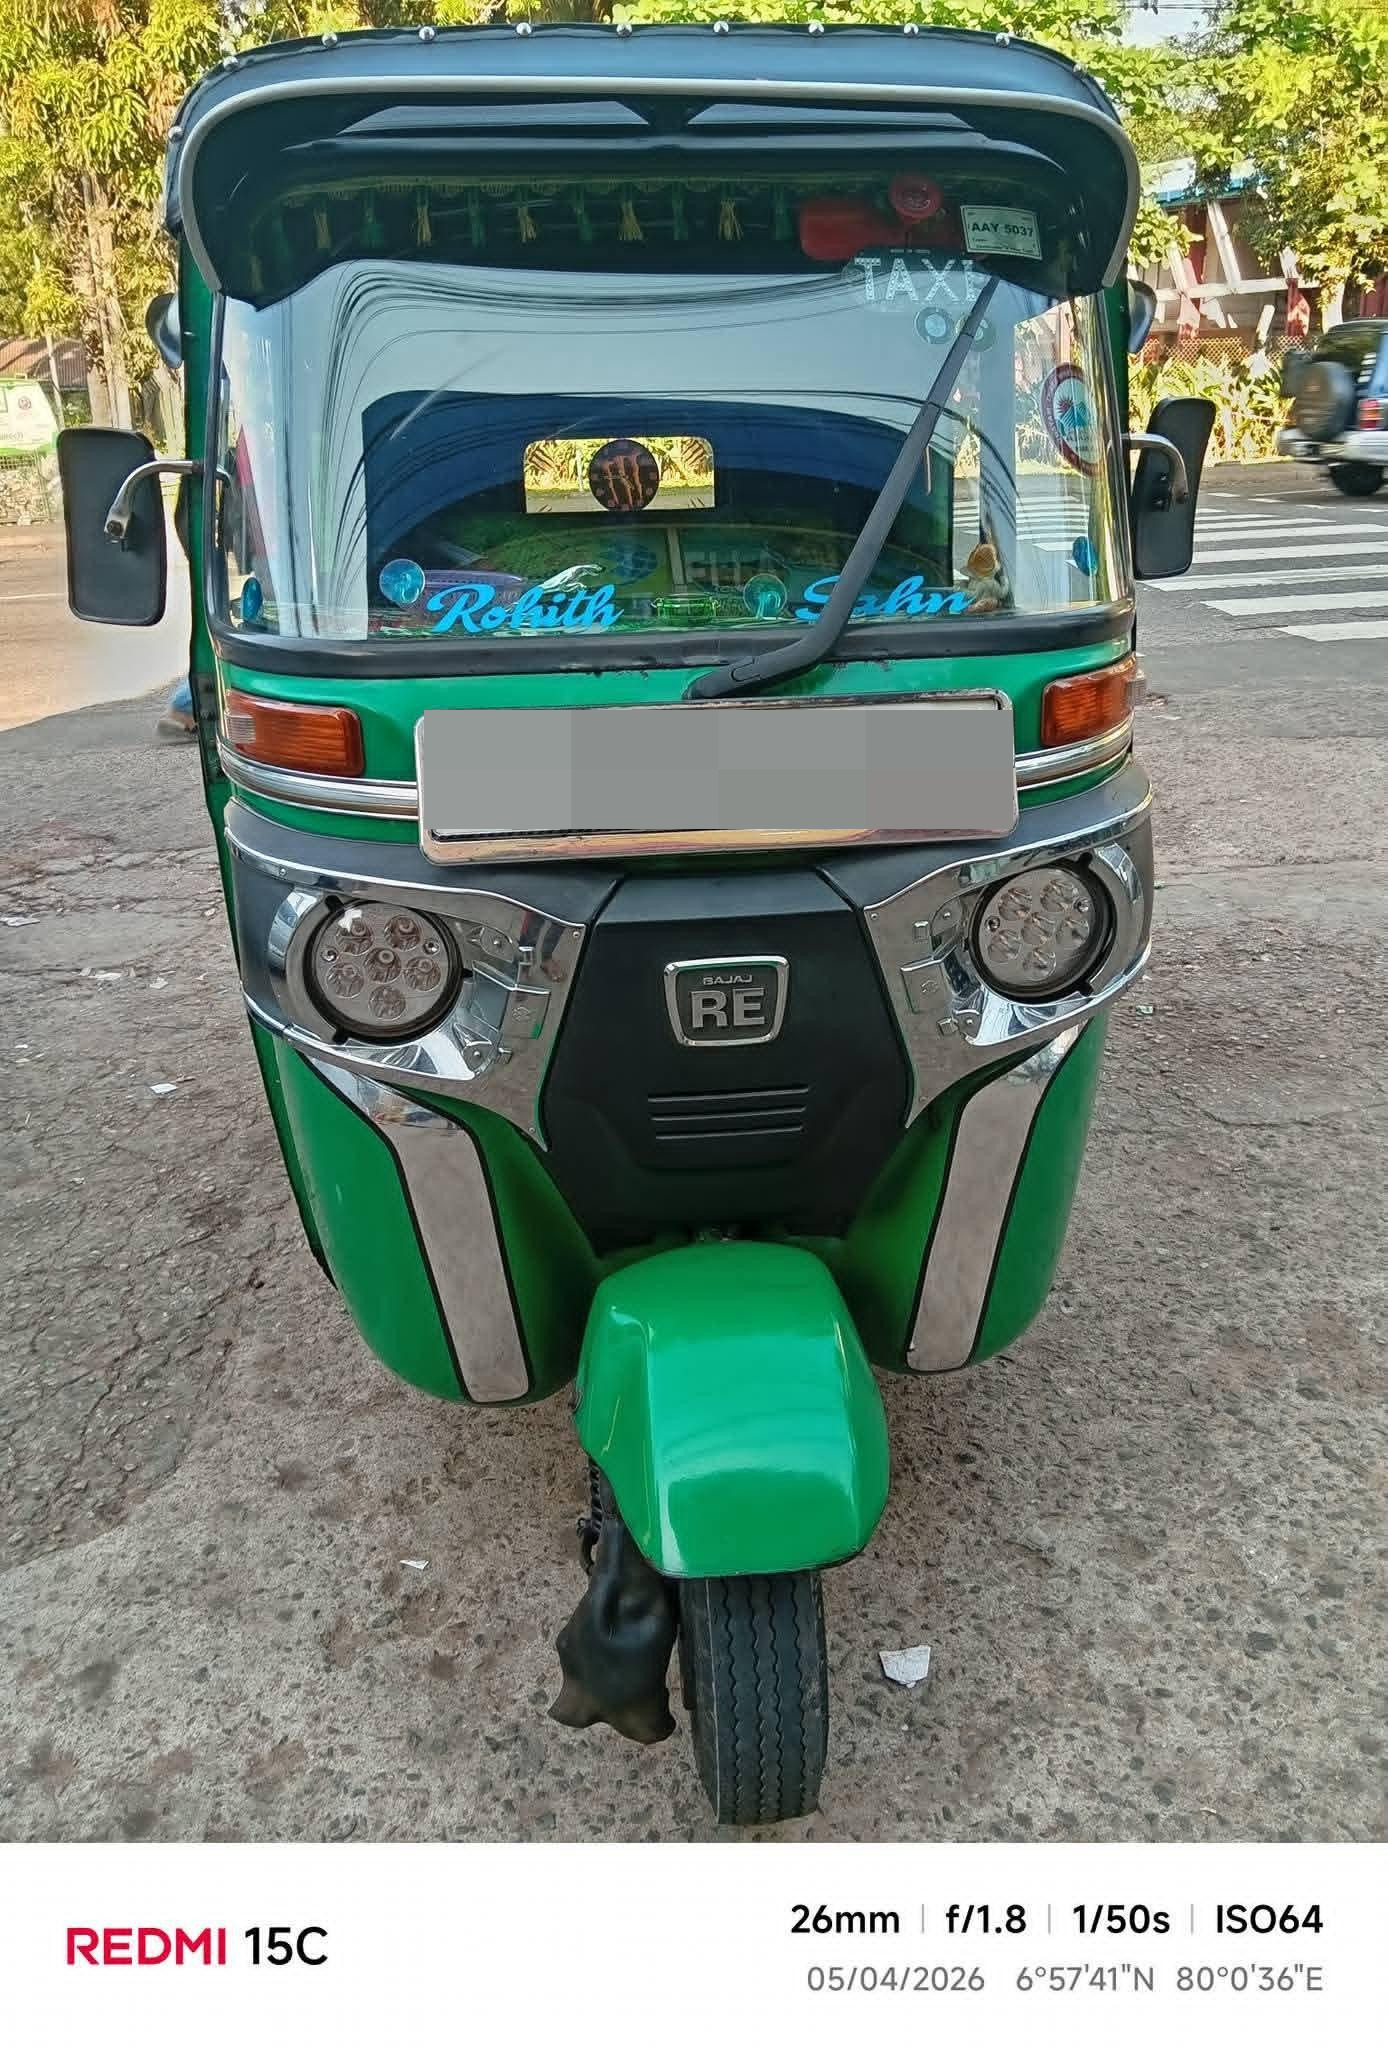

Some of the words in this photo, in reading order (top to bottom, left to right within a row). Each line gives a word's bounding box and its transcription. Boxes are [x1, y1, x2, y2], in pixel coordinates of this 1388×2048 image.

[972, 222, 999, 233] AAY
[1004, 223, 1033, 238] 5037
[854, 257, 979, 302] TAXI
[426, 583, 625, 633] Rohith
[703, 974, 753, 986] BAJAJ
[690, 987, 766, 1029] RE
